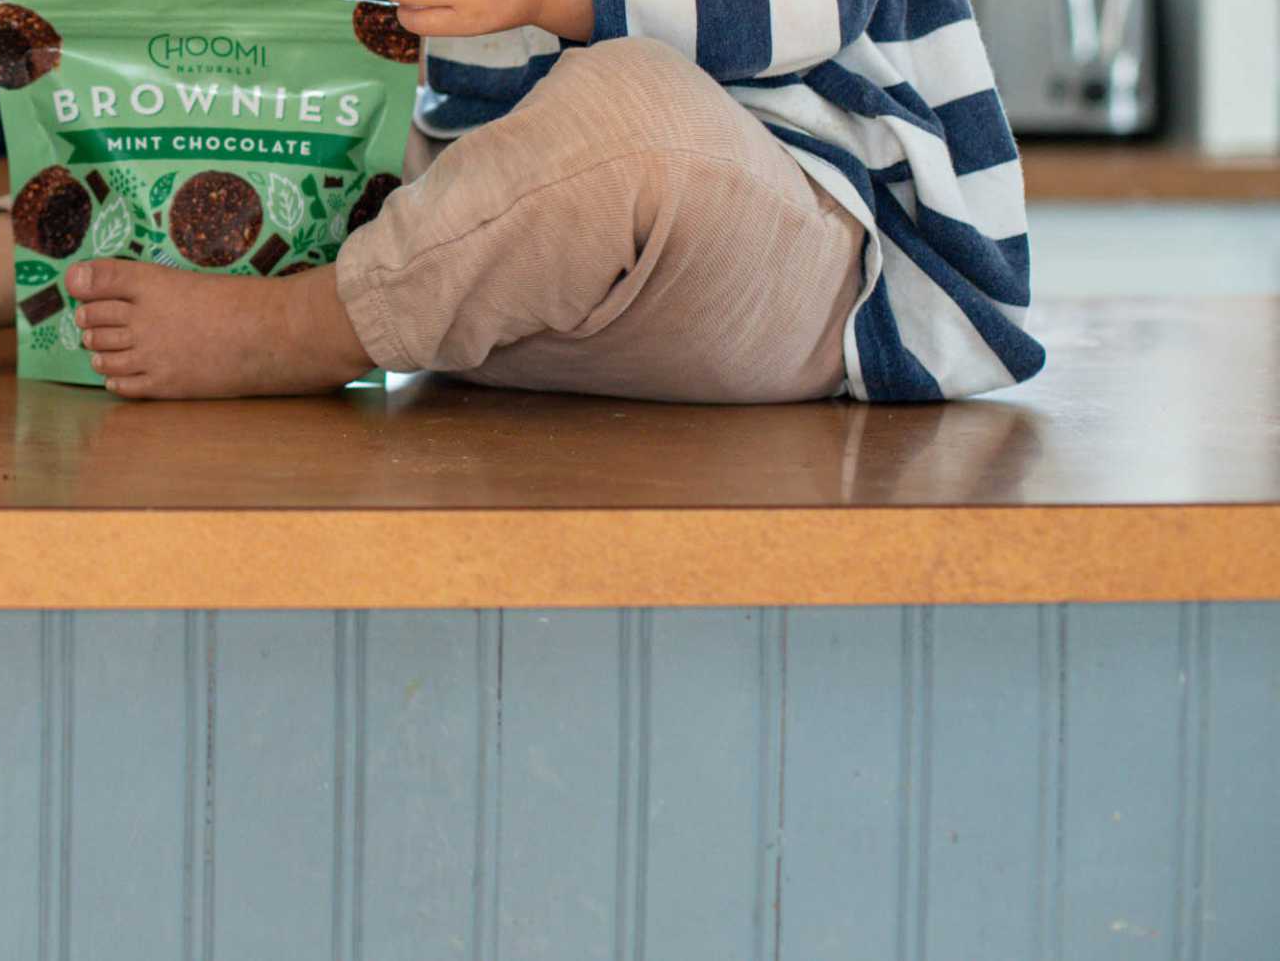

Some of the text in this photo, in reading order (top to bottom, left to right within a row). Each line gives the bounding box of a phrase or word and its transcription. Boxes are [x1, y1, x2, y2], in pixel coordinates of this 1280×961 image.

[148, 34, 266, 68] CHOOMI
[176, 65, 253, 75] NATURALS
[53, 83, 361, 127] BROWNIES
[107, 136, 312, 156] MINT CHOCOLATE
